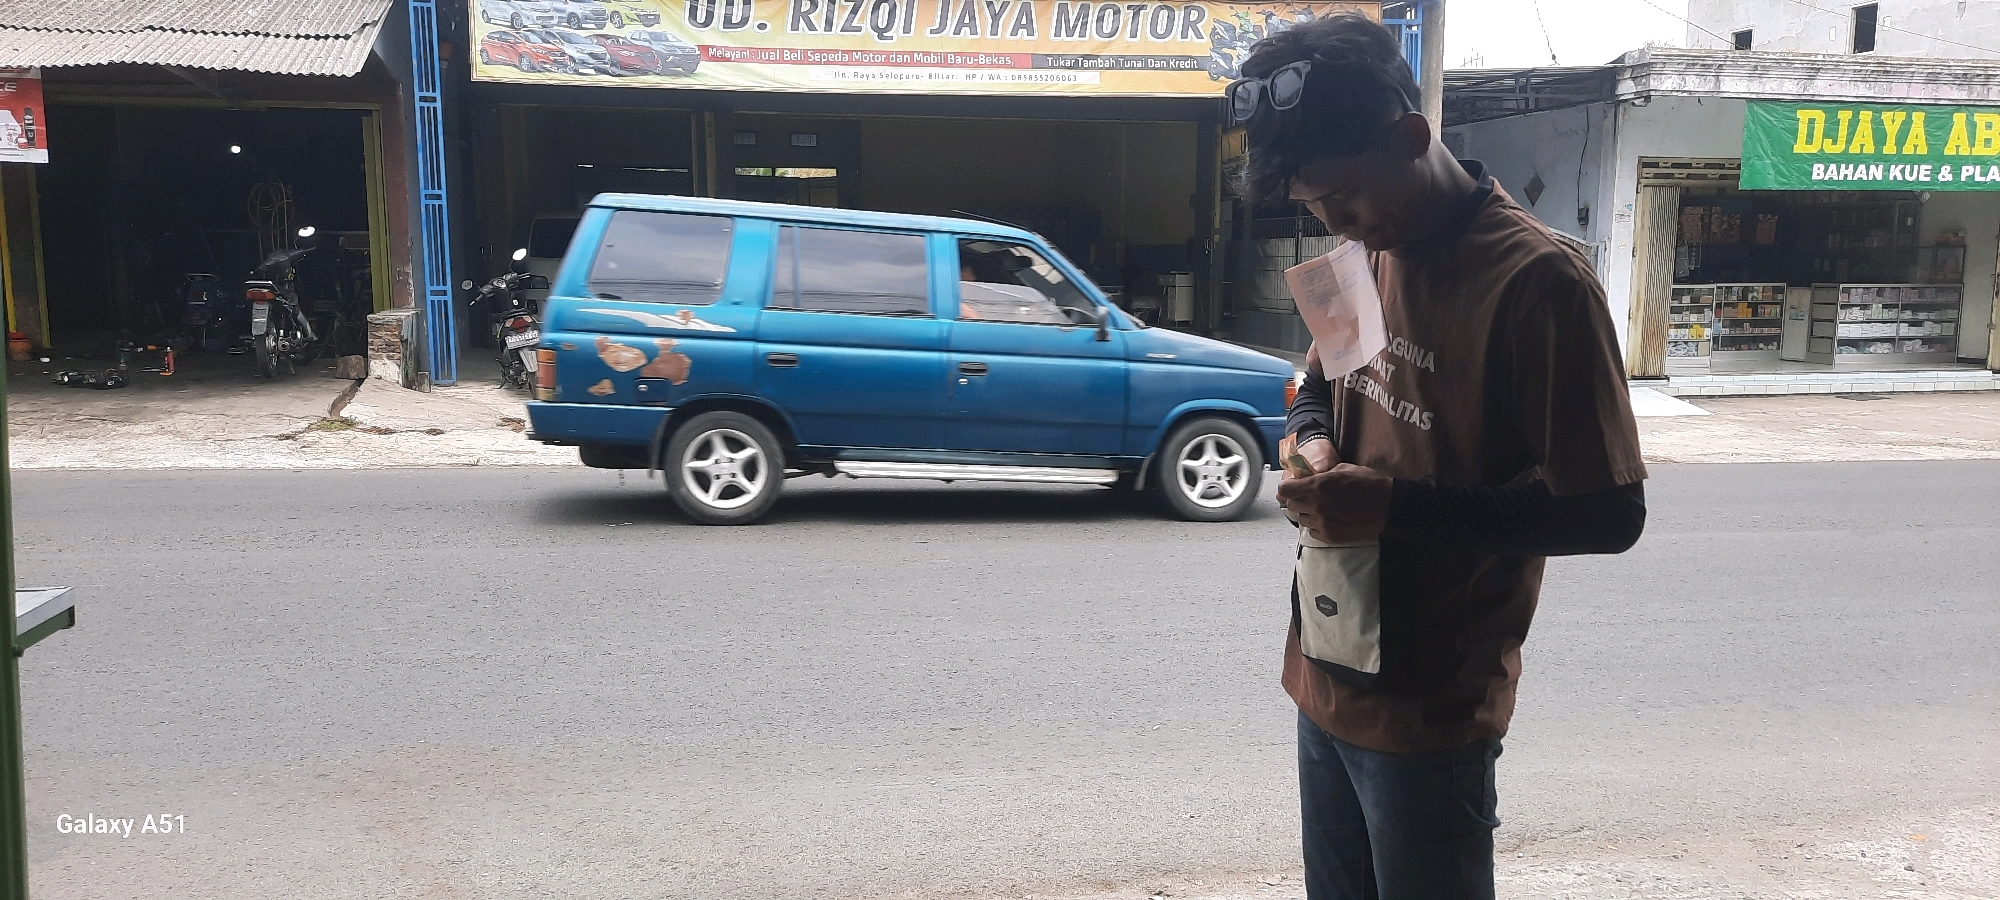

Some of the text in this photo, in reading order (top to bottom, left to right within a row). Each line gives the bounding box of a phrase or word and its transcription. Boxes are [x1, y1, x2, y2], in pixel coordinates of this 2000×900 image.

[686, 0, 1207, 42] UD. RIZQI JAYA MOTOR
[757, 50, 780, 61] Jual
[784, 50, 805, 61] Beli
[808, 50, 848, 64] Sepeda
[852, 52, 886, 63] Motor
[889, 52, 911, 63] dan
[914, 52, 945, 64] Mobil
[948, 53, 1015, 66] Baru-Bekas,
[1047, 57, 1199, 69] Tukar Tambah Tunai Dan Kredit
[853, 72, 876, 80] Raya
[1793, 109, 2000, 156] DJAYA AB
[1812, 163, 2000, 182] BAHAN KUE & PLA
[1344, 371, 1434, 431] BERKUALITAS
